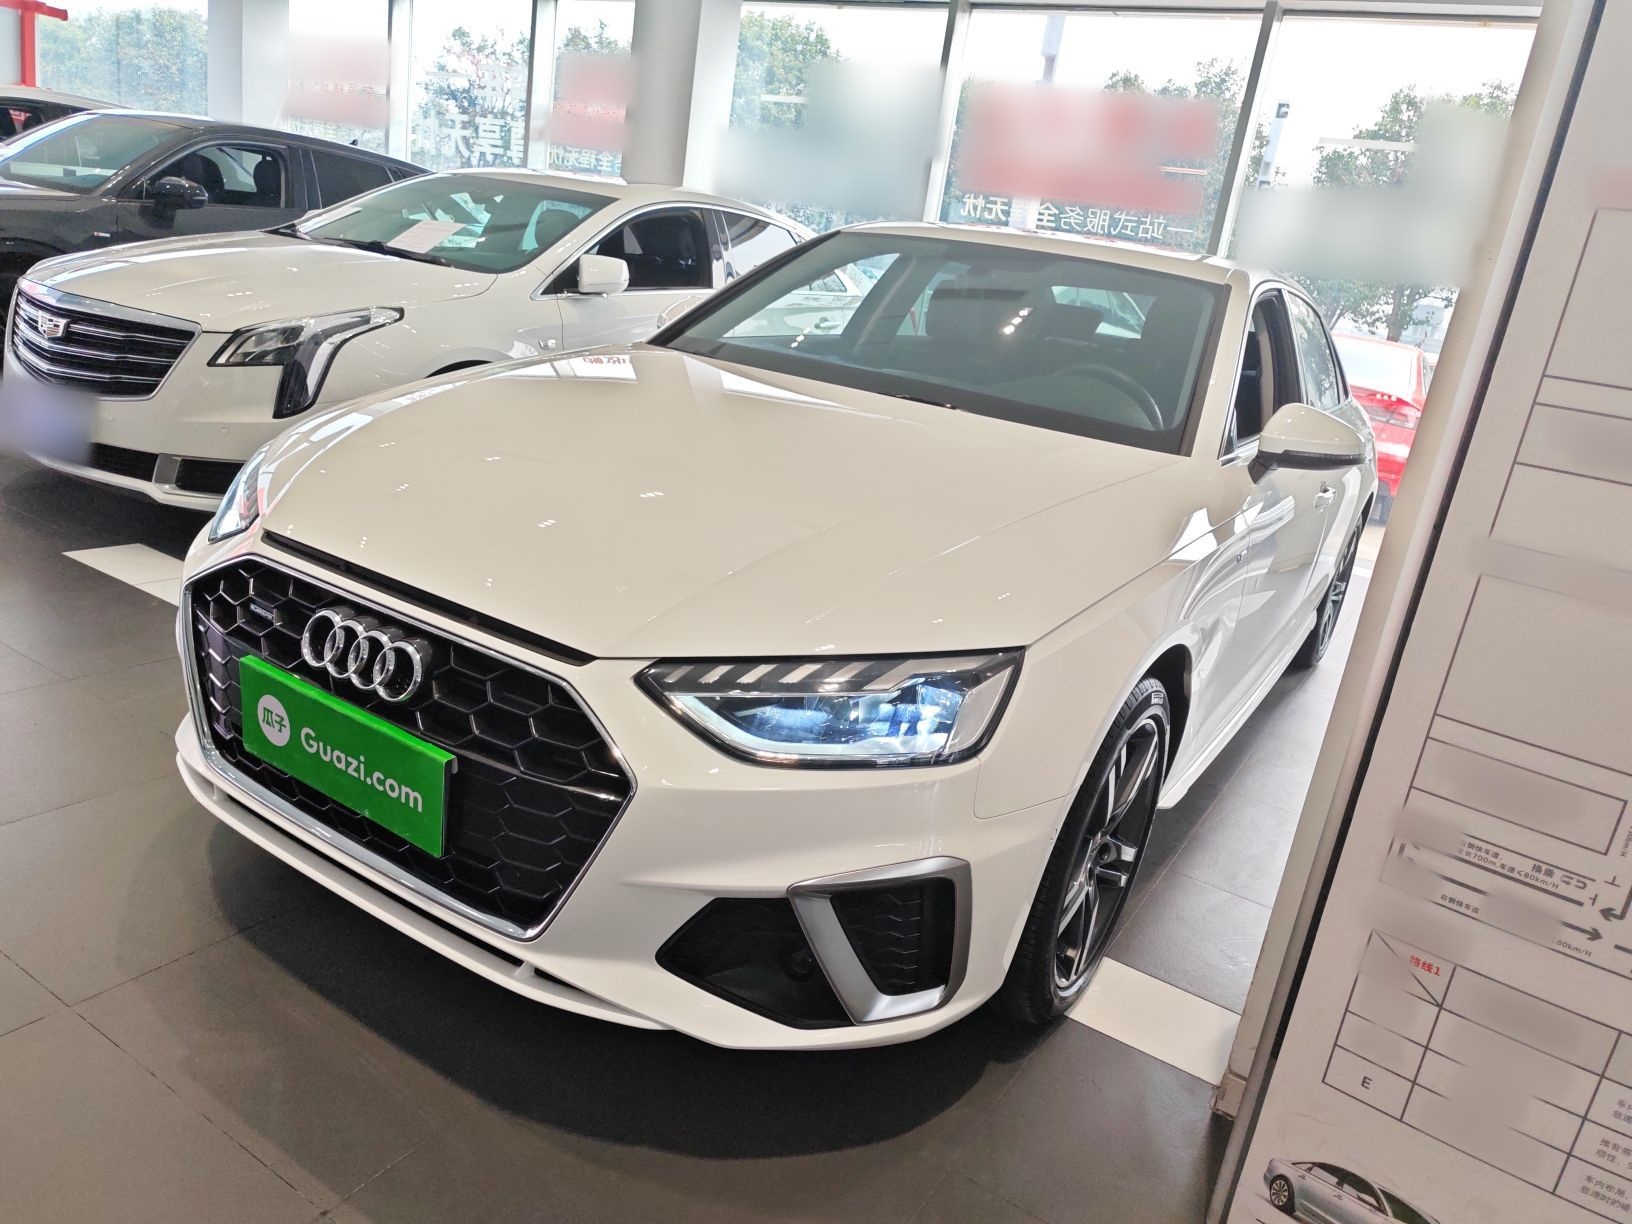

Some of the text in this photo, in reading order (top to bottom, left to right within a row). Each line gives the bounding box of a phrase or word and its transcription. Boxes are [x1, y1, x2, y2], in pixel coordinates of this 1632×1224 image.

[262, 706, 287, 733] 瓜子
[301, 727, 423, 813] Guazi.com
[1410, 954, 1440, 976] 路线1
[1361, 1076, 1372, 1089] E
